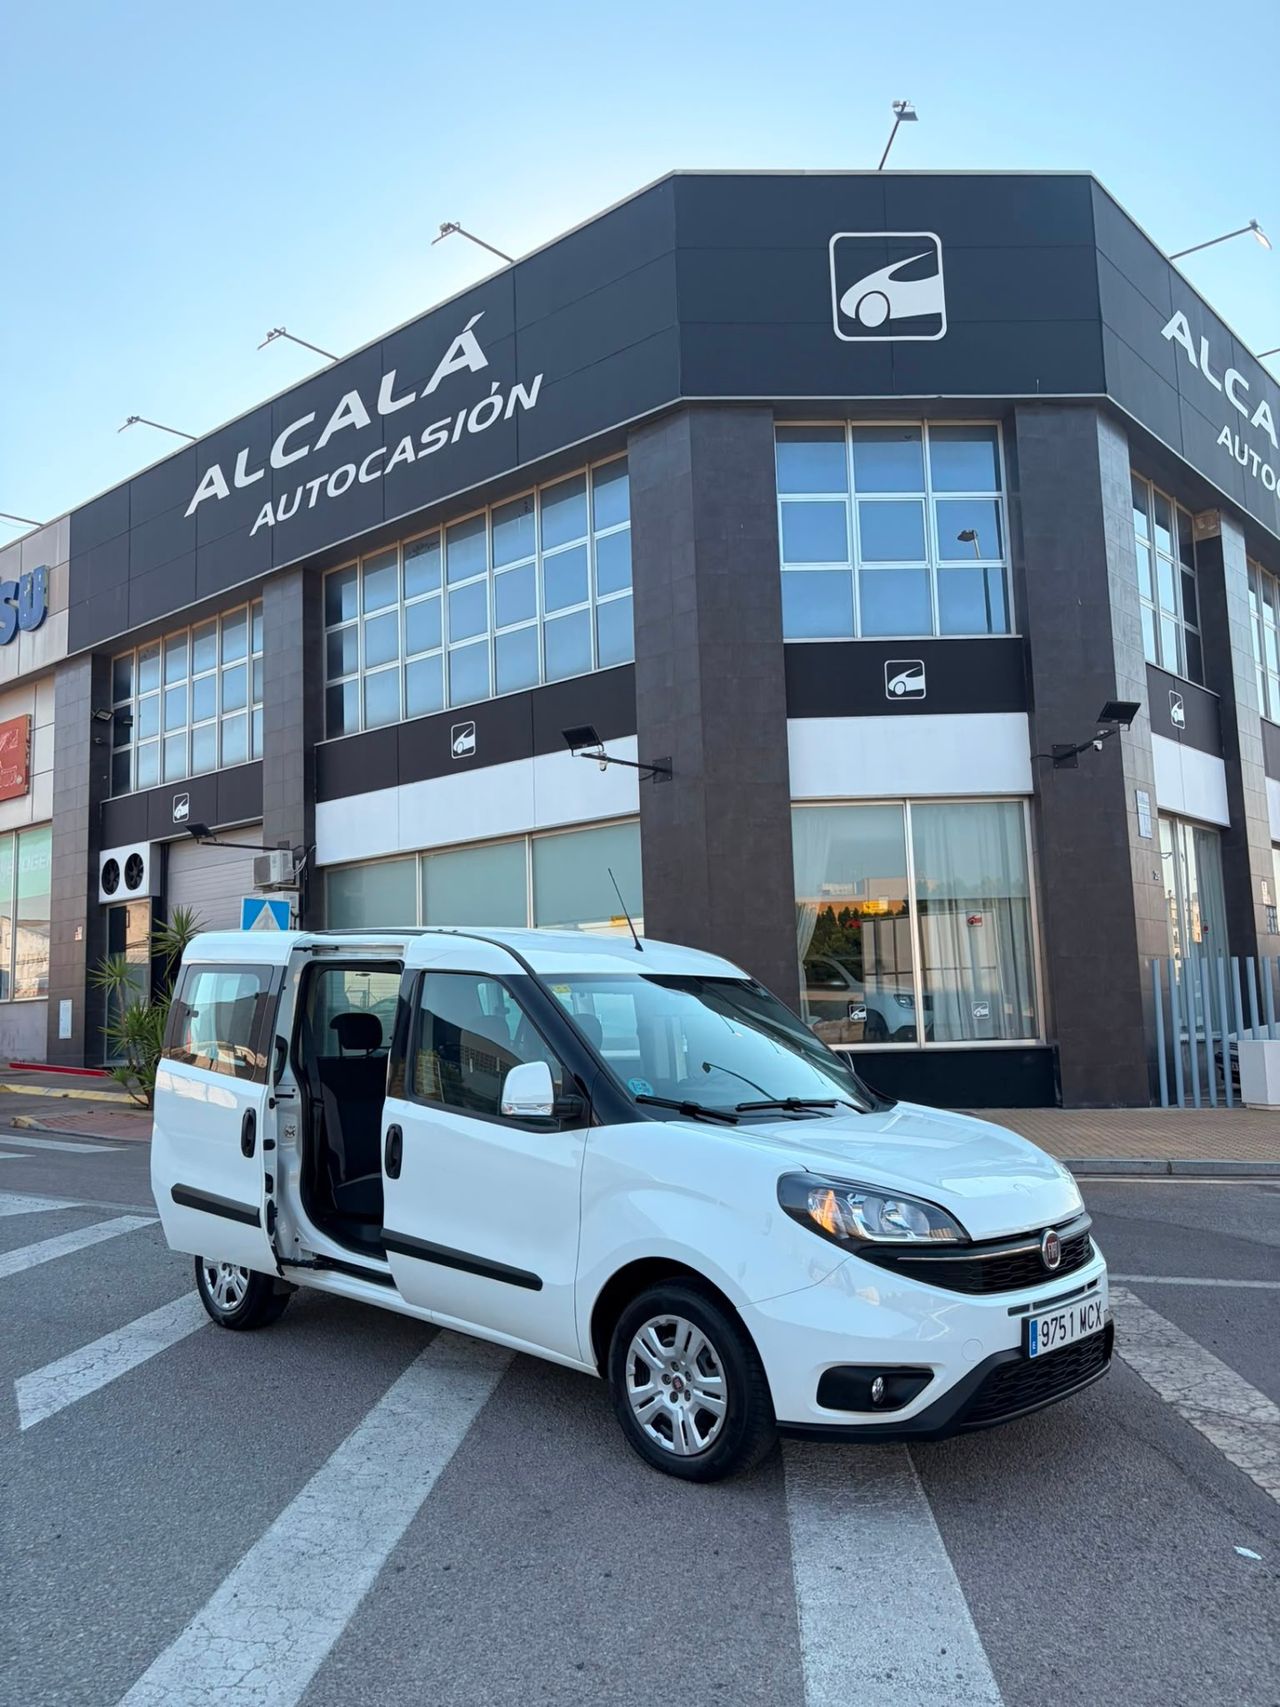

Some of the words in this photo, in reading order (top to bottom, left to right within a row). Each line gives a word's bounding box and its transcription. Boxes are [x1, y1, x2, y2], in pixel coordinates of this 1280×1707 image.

[184, 311, 489, 518] ALCALÁ
[1161, 310, 1280, 450] ALCA
[249, 373, 544, 537] AUTOCASIÓN
[1216, 425, 1280, 500] AUTO
[1041, 1312, 1073, 1347] 9751
[1080, 1301, 1101, 1333] MCX
